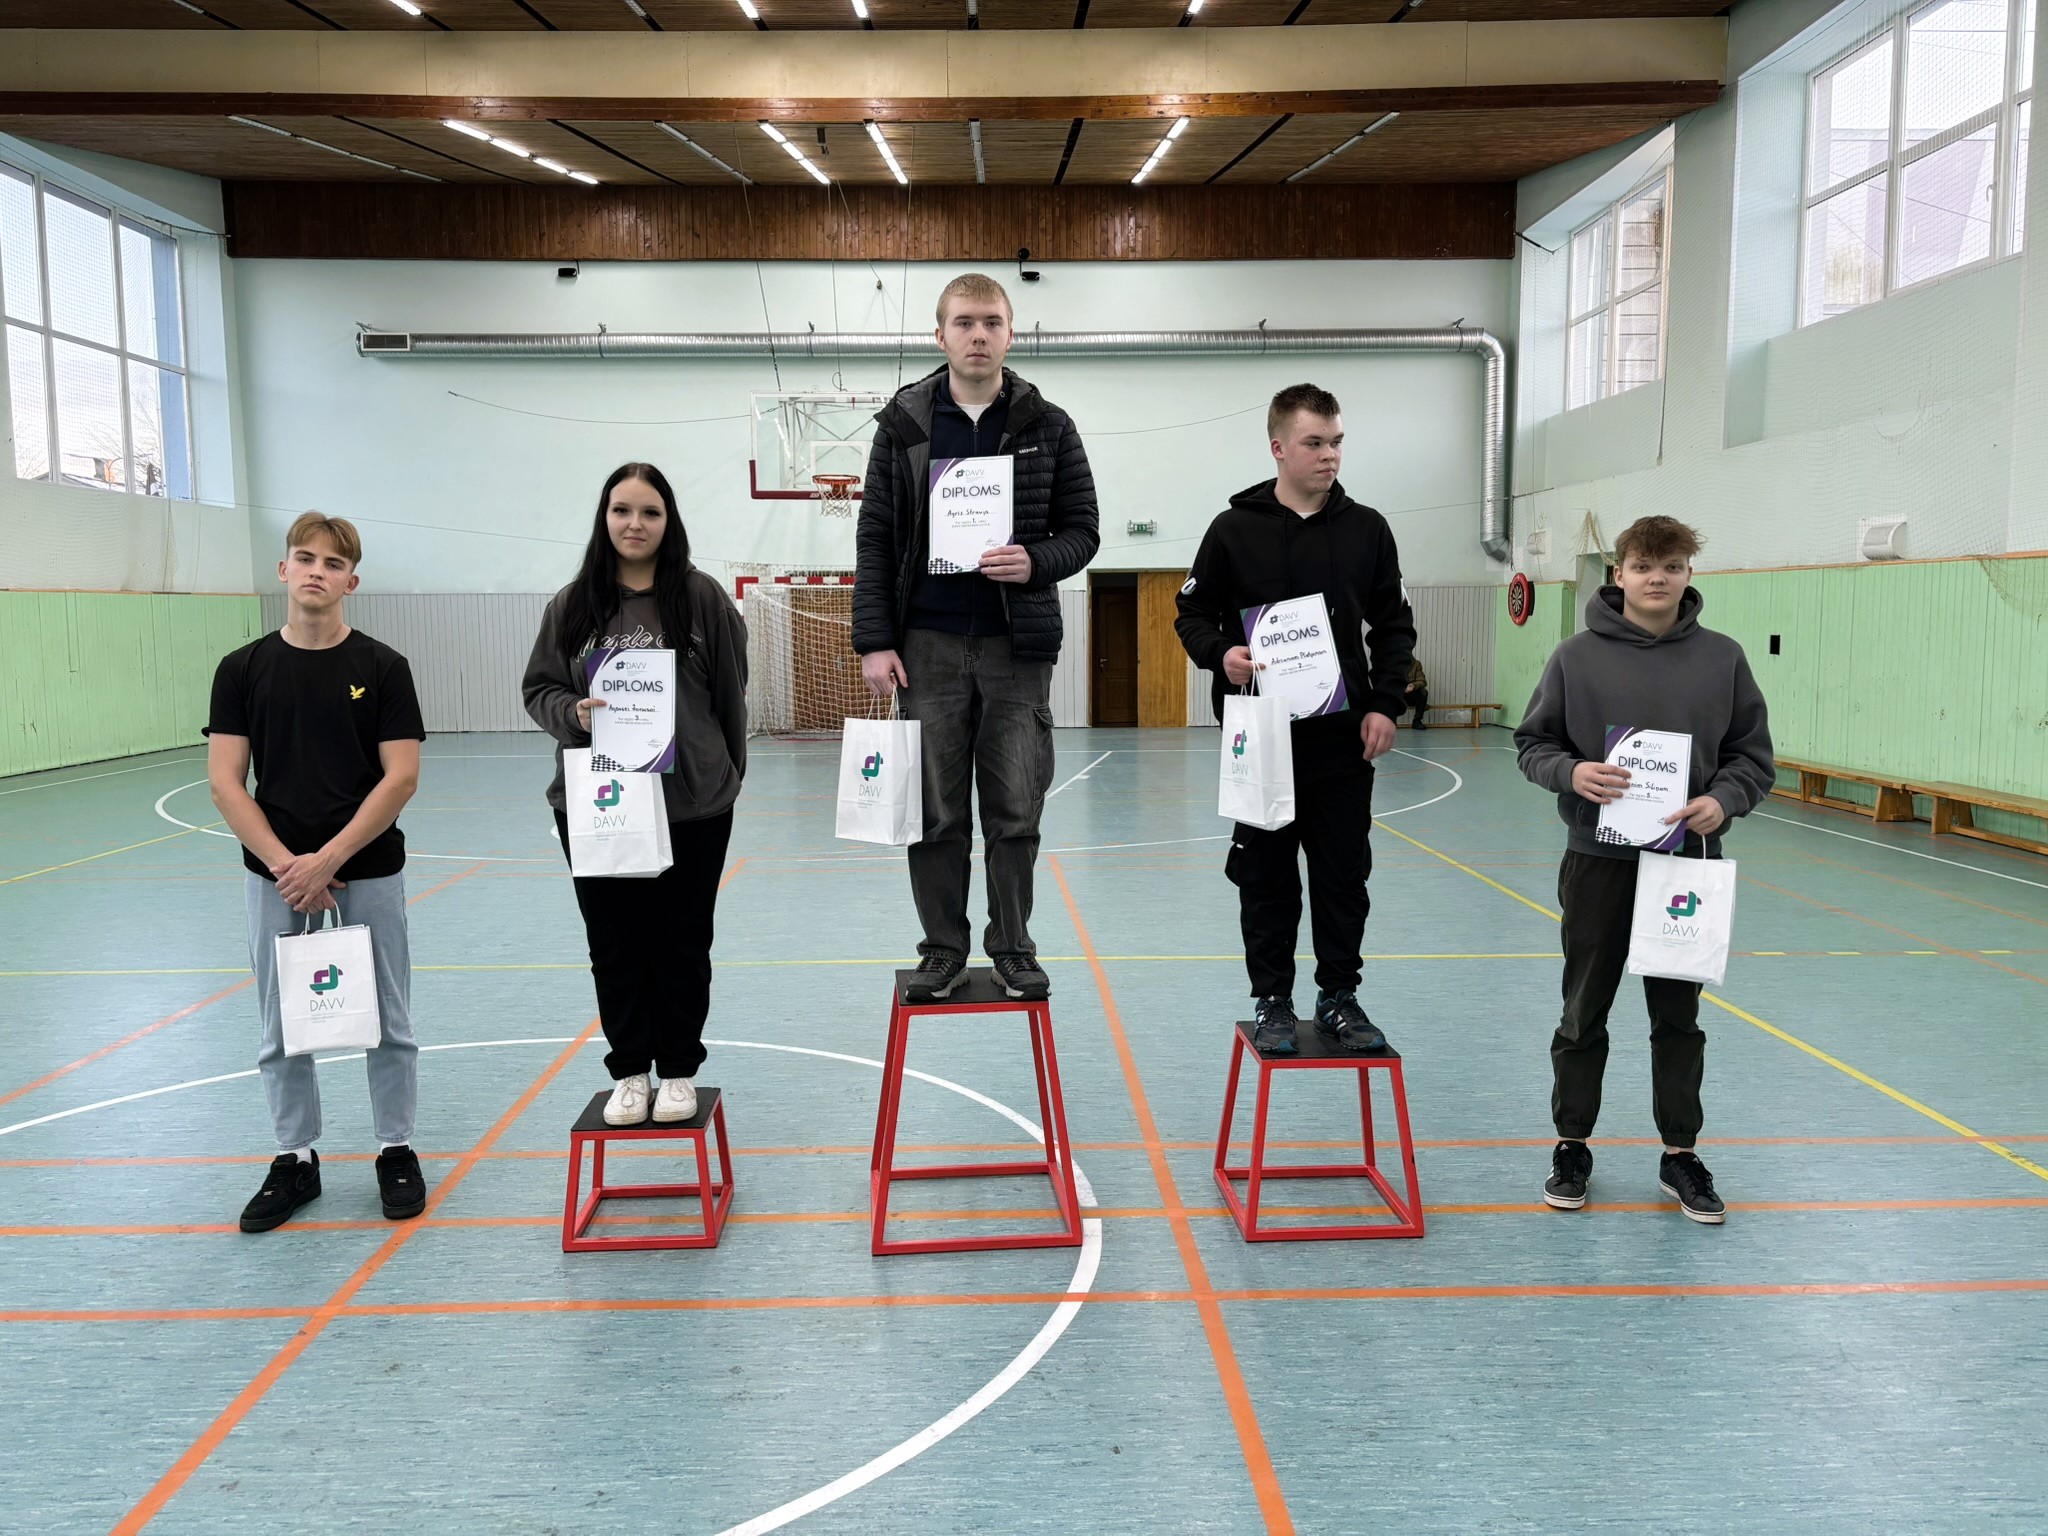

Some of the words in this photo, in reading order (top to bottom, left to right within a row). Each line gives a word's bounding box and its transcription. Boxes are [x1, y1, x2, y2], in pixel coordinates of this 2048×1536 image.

[965, 469, 985, 477] DAVV
[942, 484, 1001, 499] DIPLOMS
[1279, 611, 1299, 622] DAVV
[1260, 625, 1320, 648] DIPLOMS
[626, 662, 647, 670] DAVV
[602, 679, 664, 693] DIPLOMS
[1642, 741, 1663, 750] DAVV
[1618, 755, 1678, 774] DIPLOMS
[858, 784, 882, 797] DAVV
[593, 814, 627, 829] DAVV
[1662, 922, 1700, 938] DAVV
[309, 997, 346, 1012] DAVV
